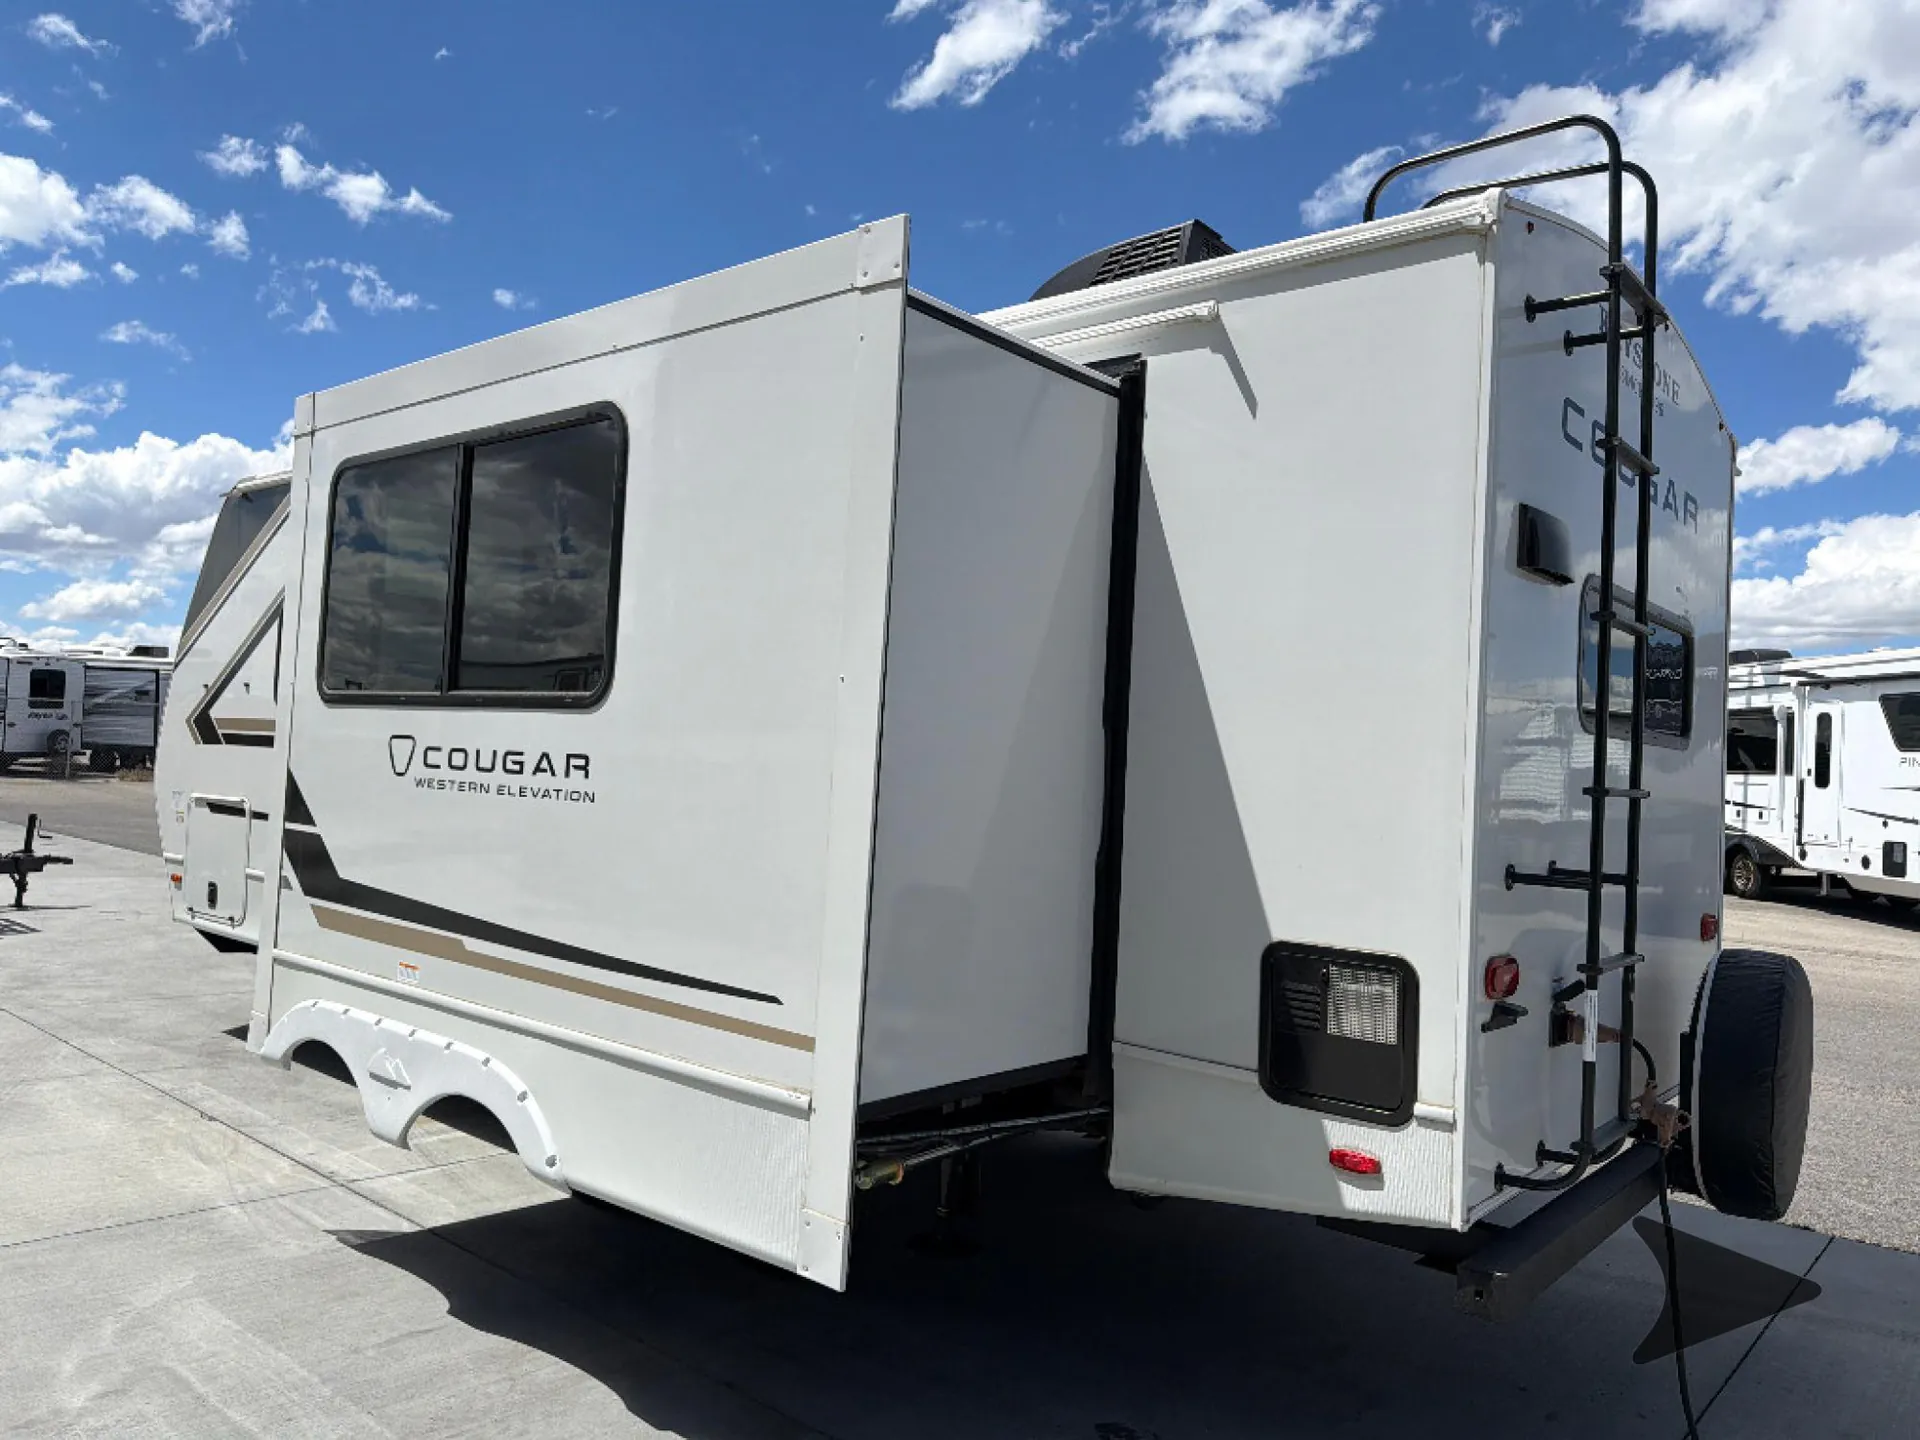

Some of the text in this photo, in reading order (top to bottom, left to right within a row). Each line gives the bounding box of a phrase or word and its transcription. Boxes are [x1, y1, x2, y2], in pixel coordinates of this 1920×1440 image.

[423, 746, 591, 779] COUGAR
[414, 776, 596, 803] WESTERN ELEVATION
